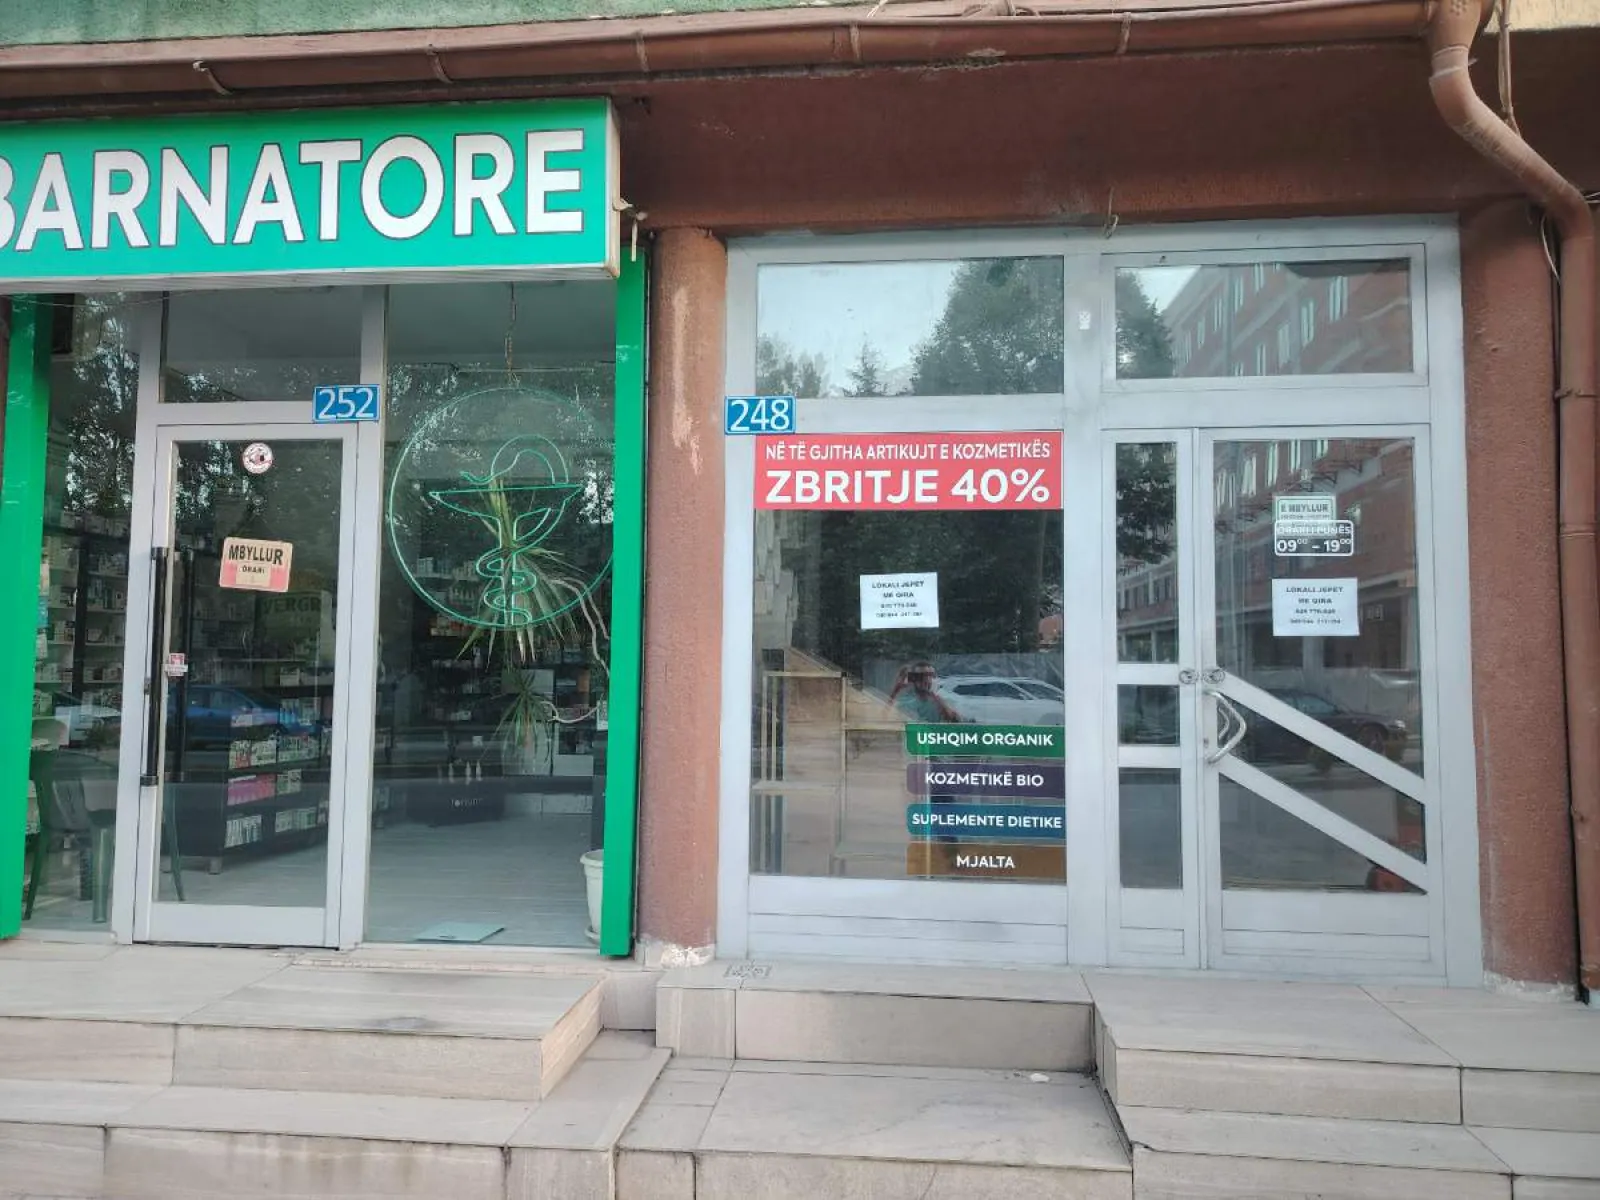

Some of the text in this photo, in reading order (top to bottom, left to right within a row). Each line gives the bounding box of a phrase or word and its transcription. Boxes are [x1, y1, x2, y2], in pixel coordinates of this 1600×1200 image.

[315, 387, 376, 420] 252
[729, 398, 790, 432] 248
[766, 440, 1051, 460] NË TË GJITHA ARTIKUJT E KOZMETIKËS
[765, 468, 1050, 504] ZBRITJE 40%
[228, 545, 284, 565] MBYLLUR
[917, 732, 1054, 747] USHQIM ORGANIK
[925, 770, 1044, 787] KOZMETIKË BIO
[912, 812, 1063, 829] SUPLEMENTE DIETIKE
[956, 855, 1015, 869] MJALTA
